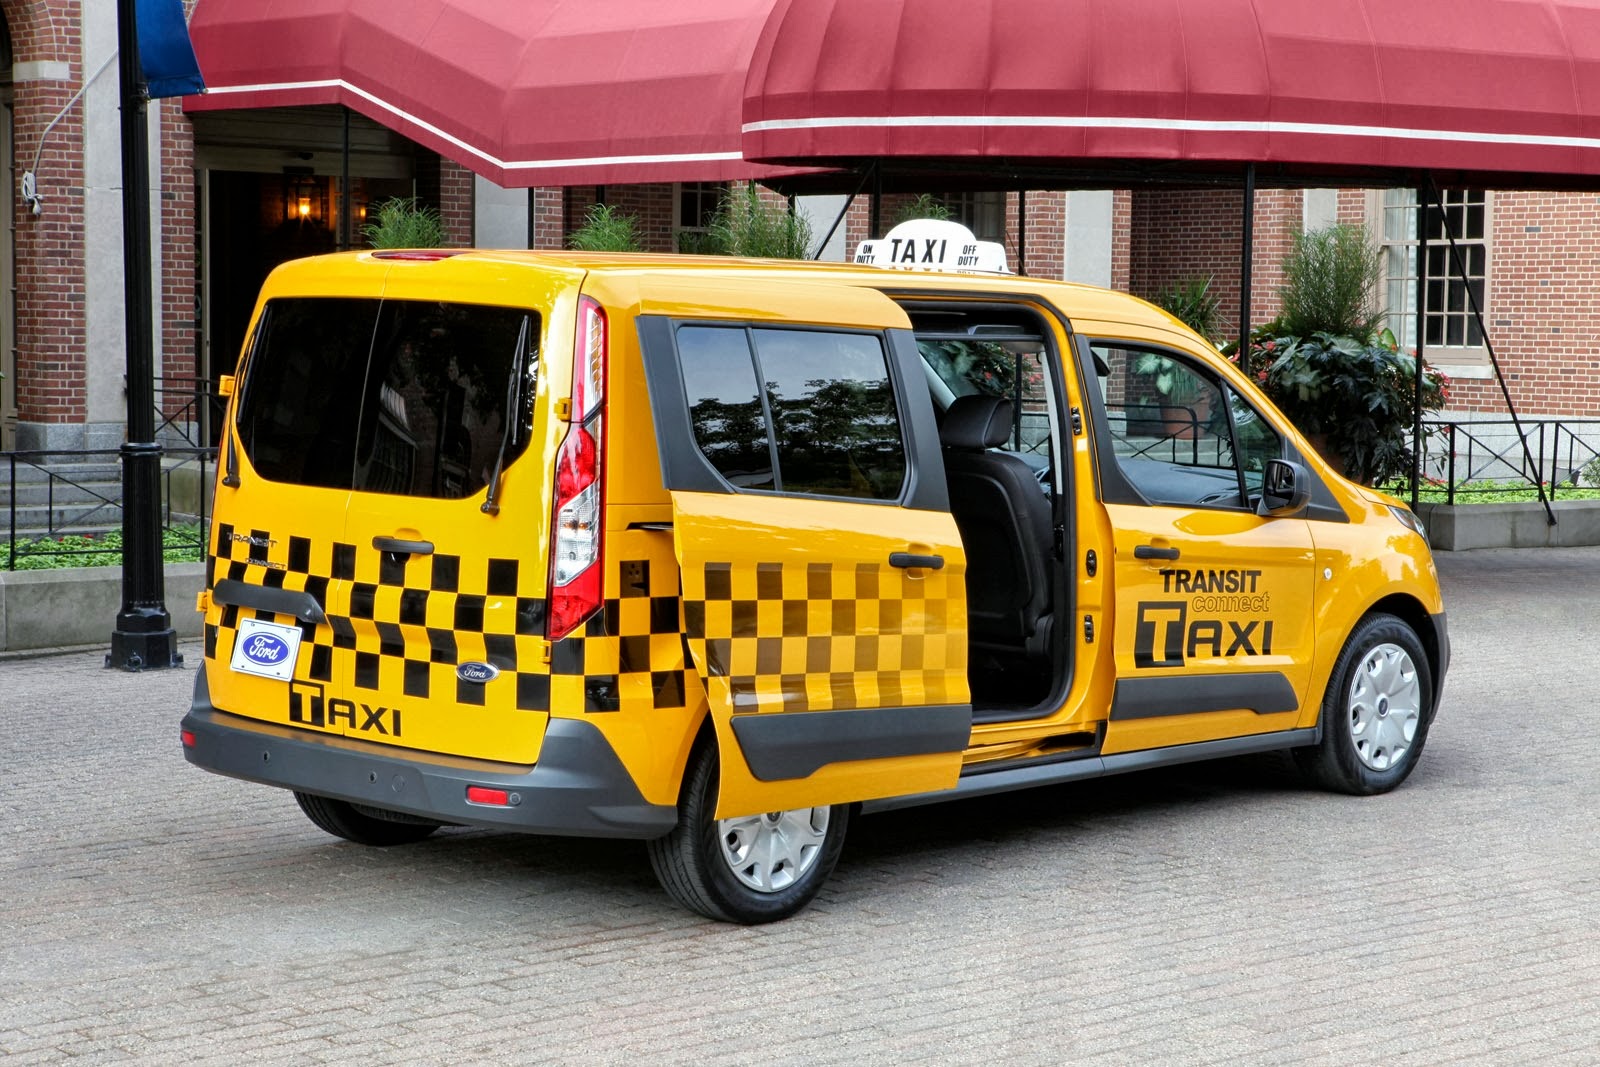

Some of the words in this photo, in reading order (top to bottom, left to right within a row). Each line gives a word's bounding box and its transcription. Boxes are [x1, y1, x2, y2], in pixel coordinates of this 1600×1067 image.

[856, 255, 875, 264] DUTY
[862, 244, 873, 255] ON
[890, 238, 947, 263] TAXI
[957, 255, 979, 266] DUTY
[962, 244, 977, 255] OFF
[1158, 569, 1262, 593] TRANSIT
[1191, 591, 1270, 613] connect
[1135, 601, 1274, 668] TAXI
[248, 635, 281, 661] Ford
[463, 664, 487, 679] Ford
[289, 679, 402, 738] TAXI
